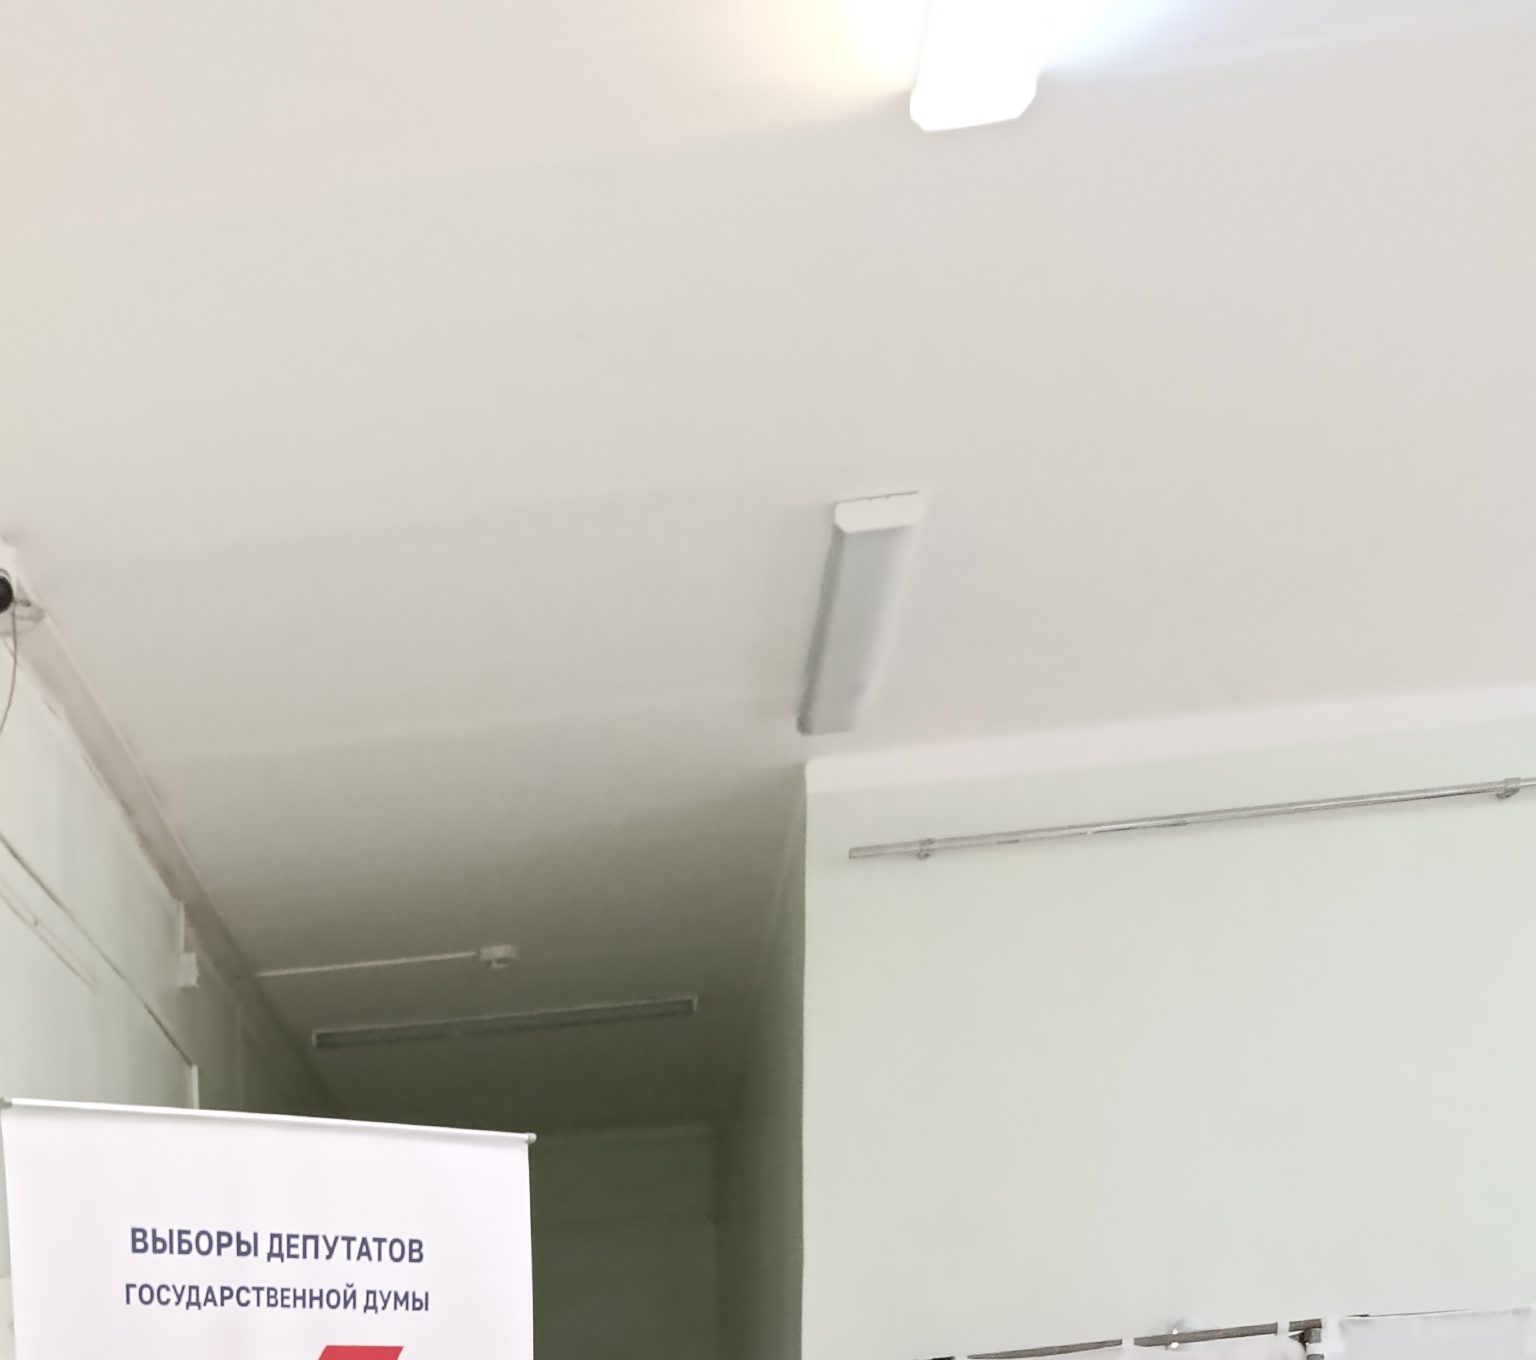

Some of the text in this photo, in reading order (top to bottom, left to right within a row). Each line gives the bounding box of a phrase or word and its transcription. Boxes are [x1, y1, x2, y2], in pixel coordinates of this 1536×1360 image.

[130, 1227, 424, 1263] ВЫБОРЫ ДЕПУТАТОВ
[125, 1283, 429, 1314] ГОСУДАРСТВЕННОЙ ДУМЫ
